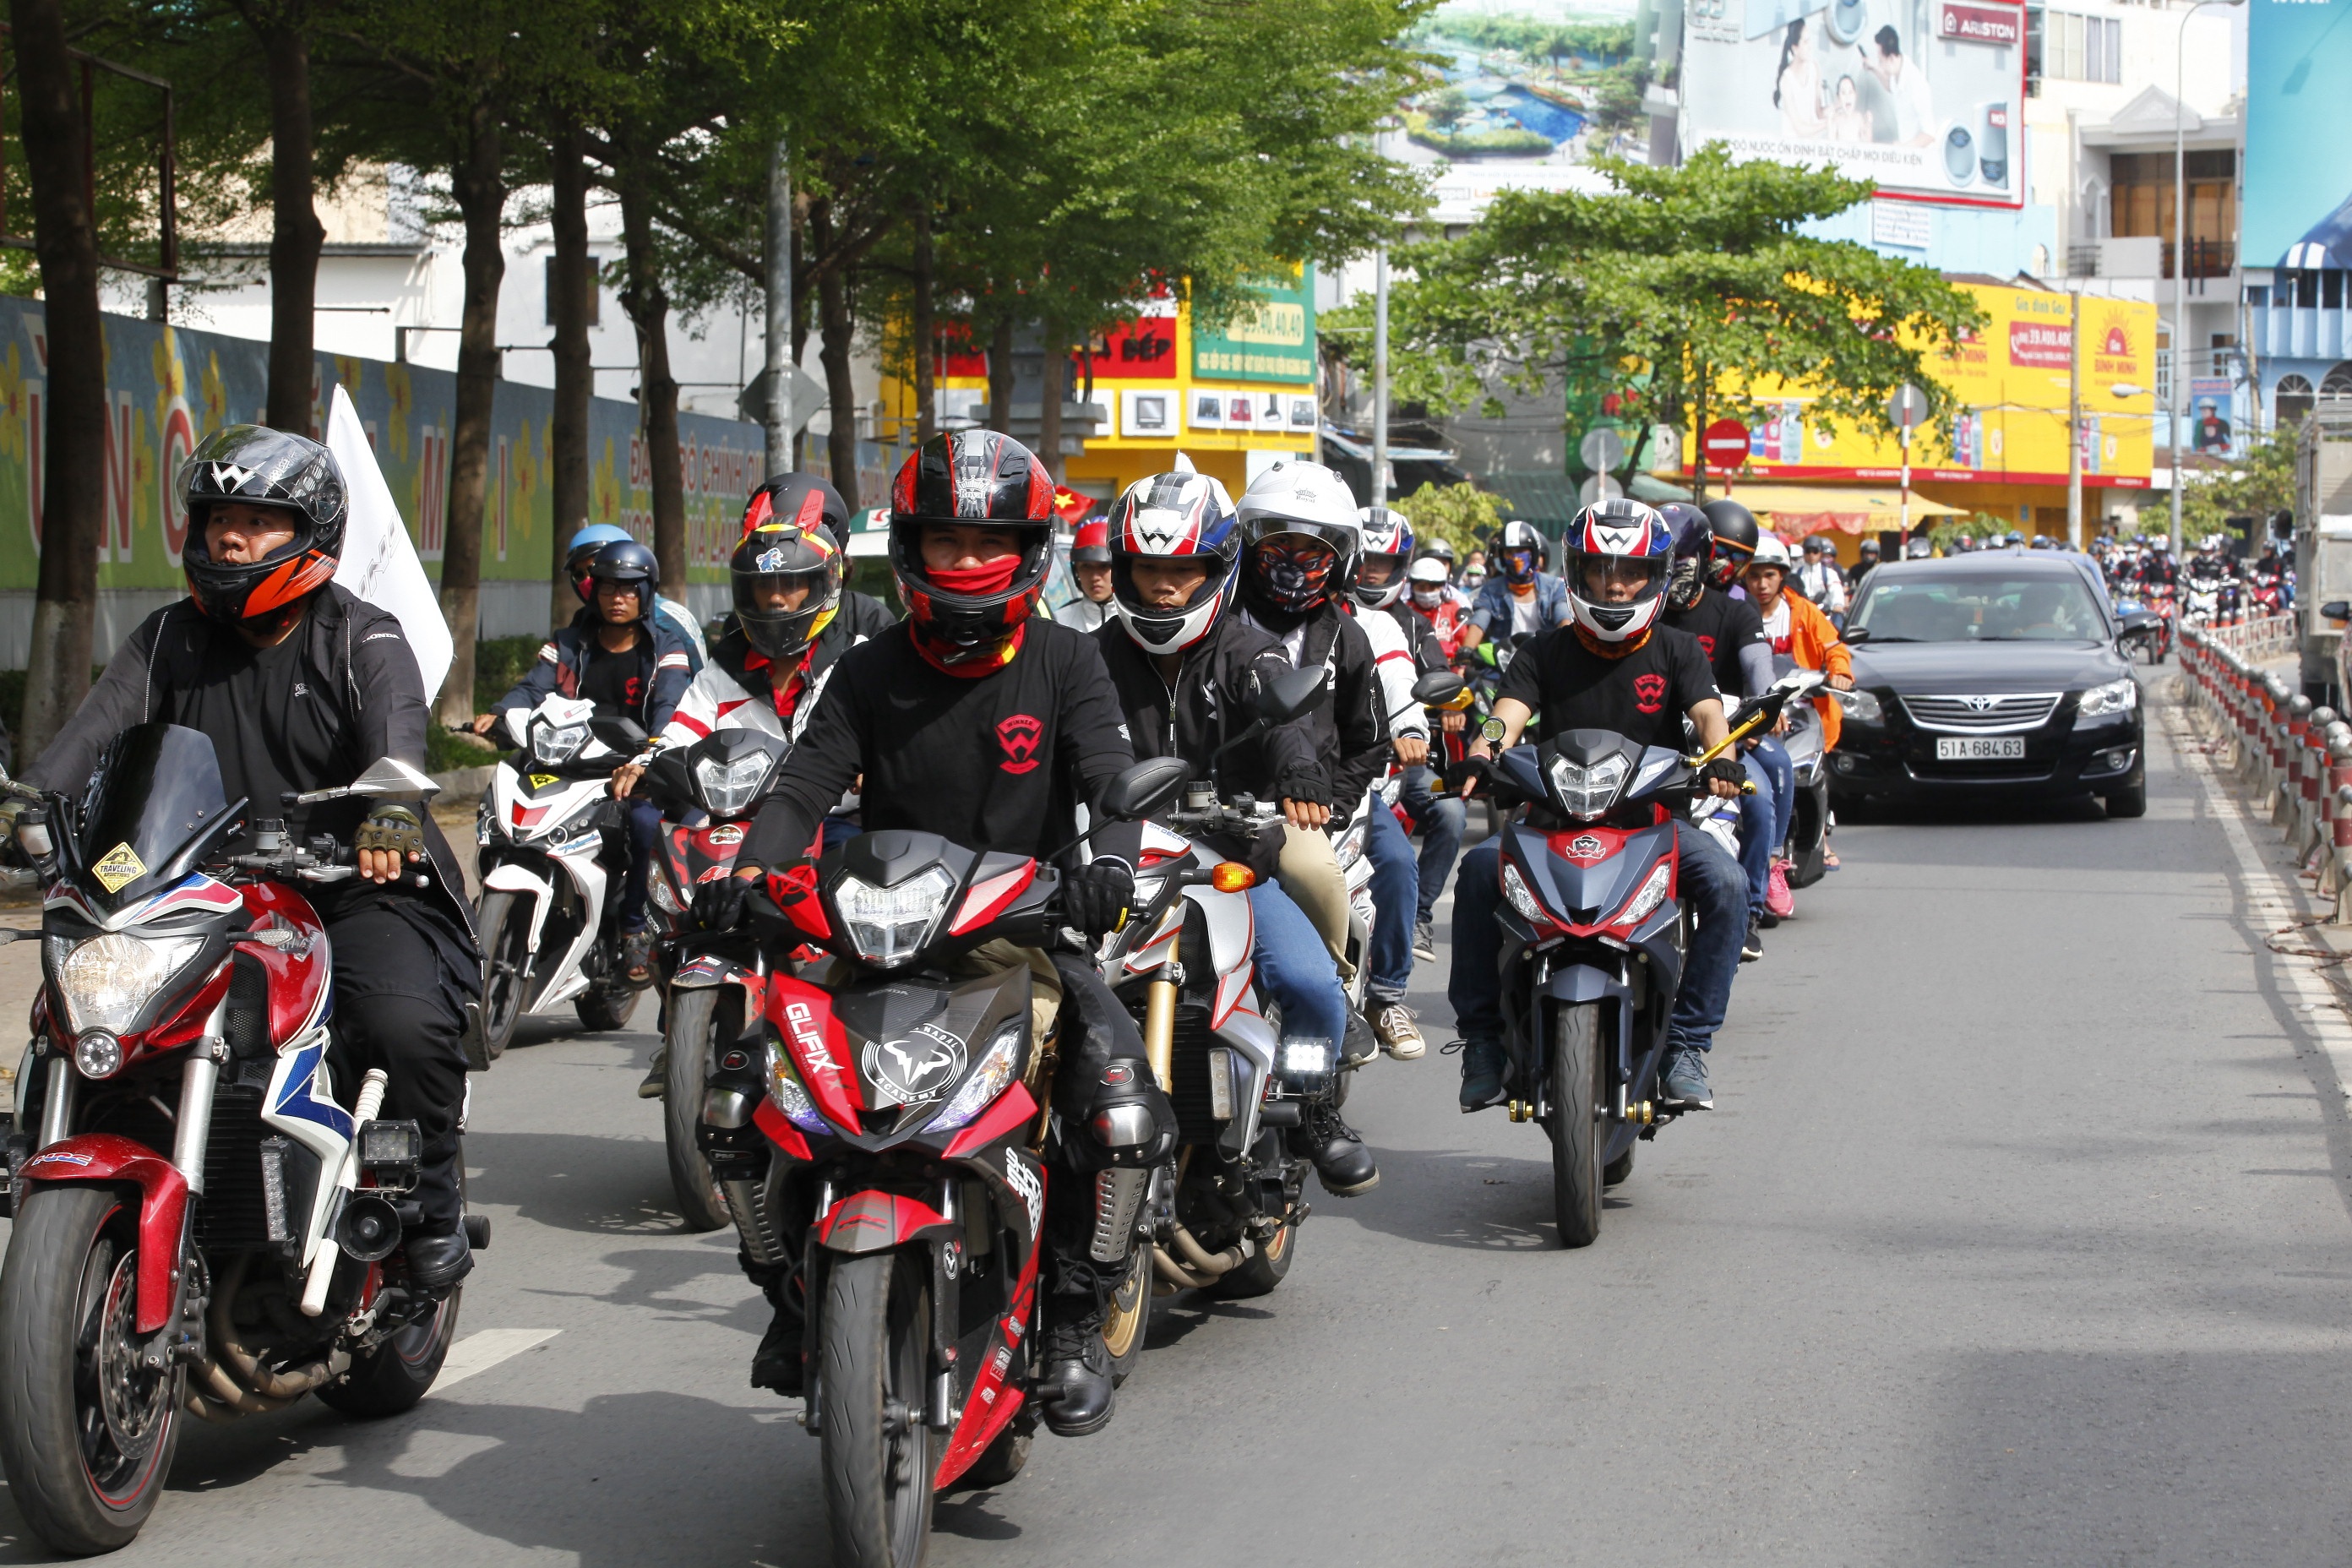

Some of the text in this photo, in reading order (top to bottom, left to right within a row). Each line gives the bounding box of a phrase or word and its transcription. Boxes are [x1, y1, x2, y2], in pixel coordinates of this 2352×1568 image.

[1961, 19, 2015, 40] ARISTON
[1296, 495, 1315, 504] Royal
[1006, 718, 1033, 728] WINNER
[101, 864, 137, 874] TRAVELING
[1663, 916, 1676, 928] 150
[786, 1002, 846, 1074] GLIFIX
[923, 1025, 959, 1049] NADAL
[875, 1077, 938, 1103] ACADEMY
